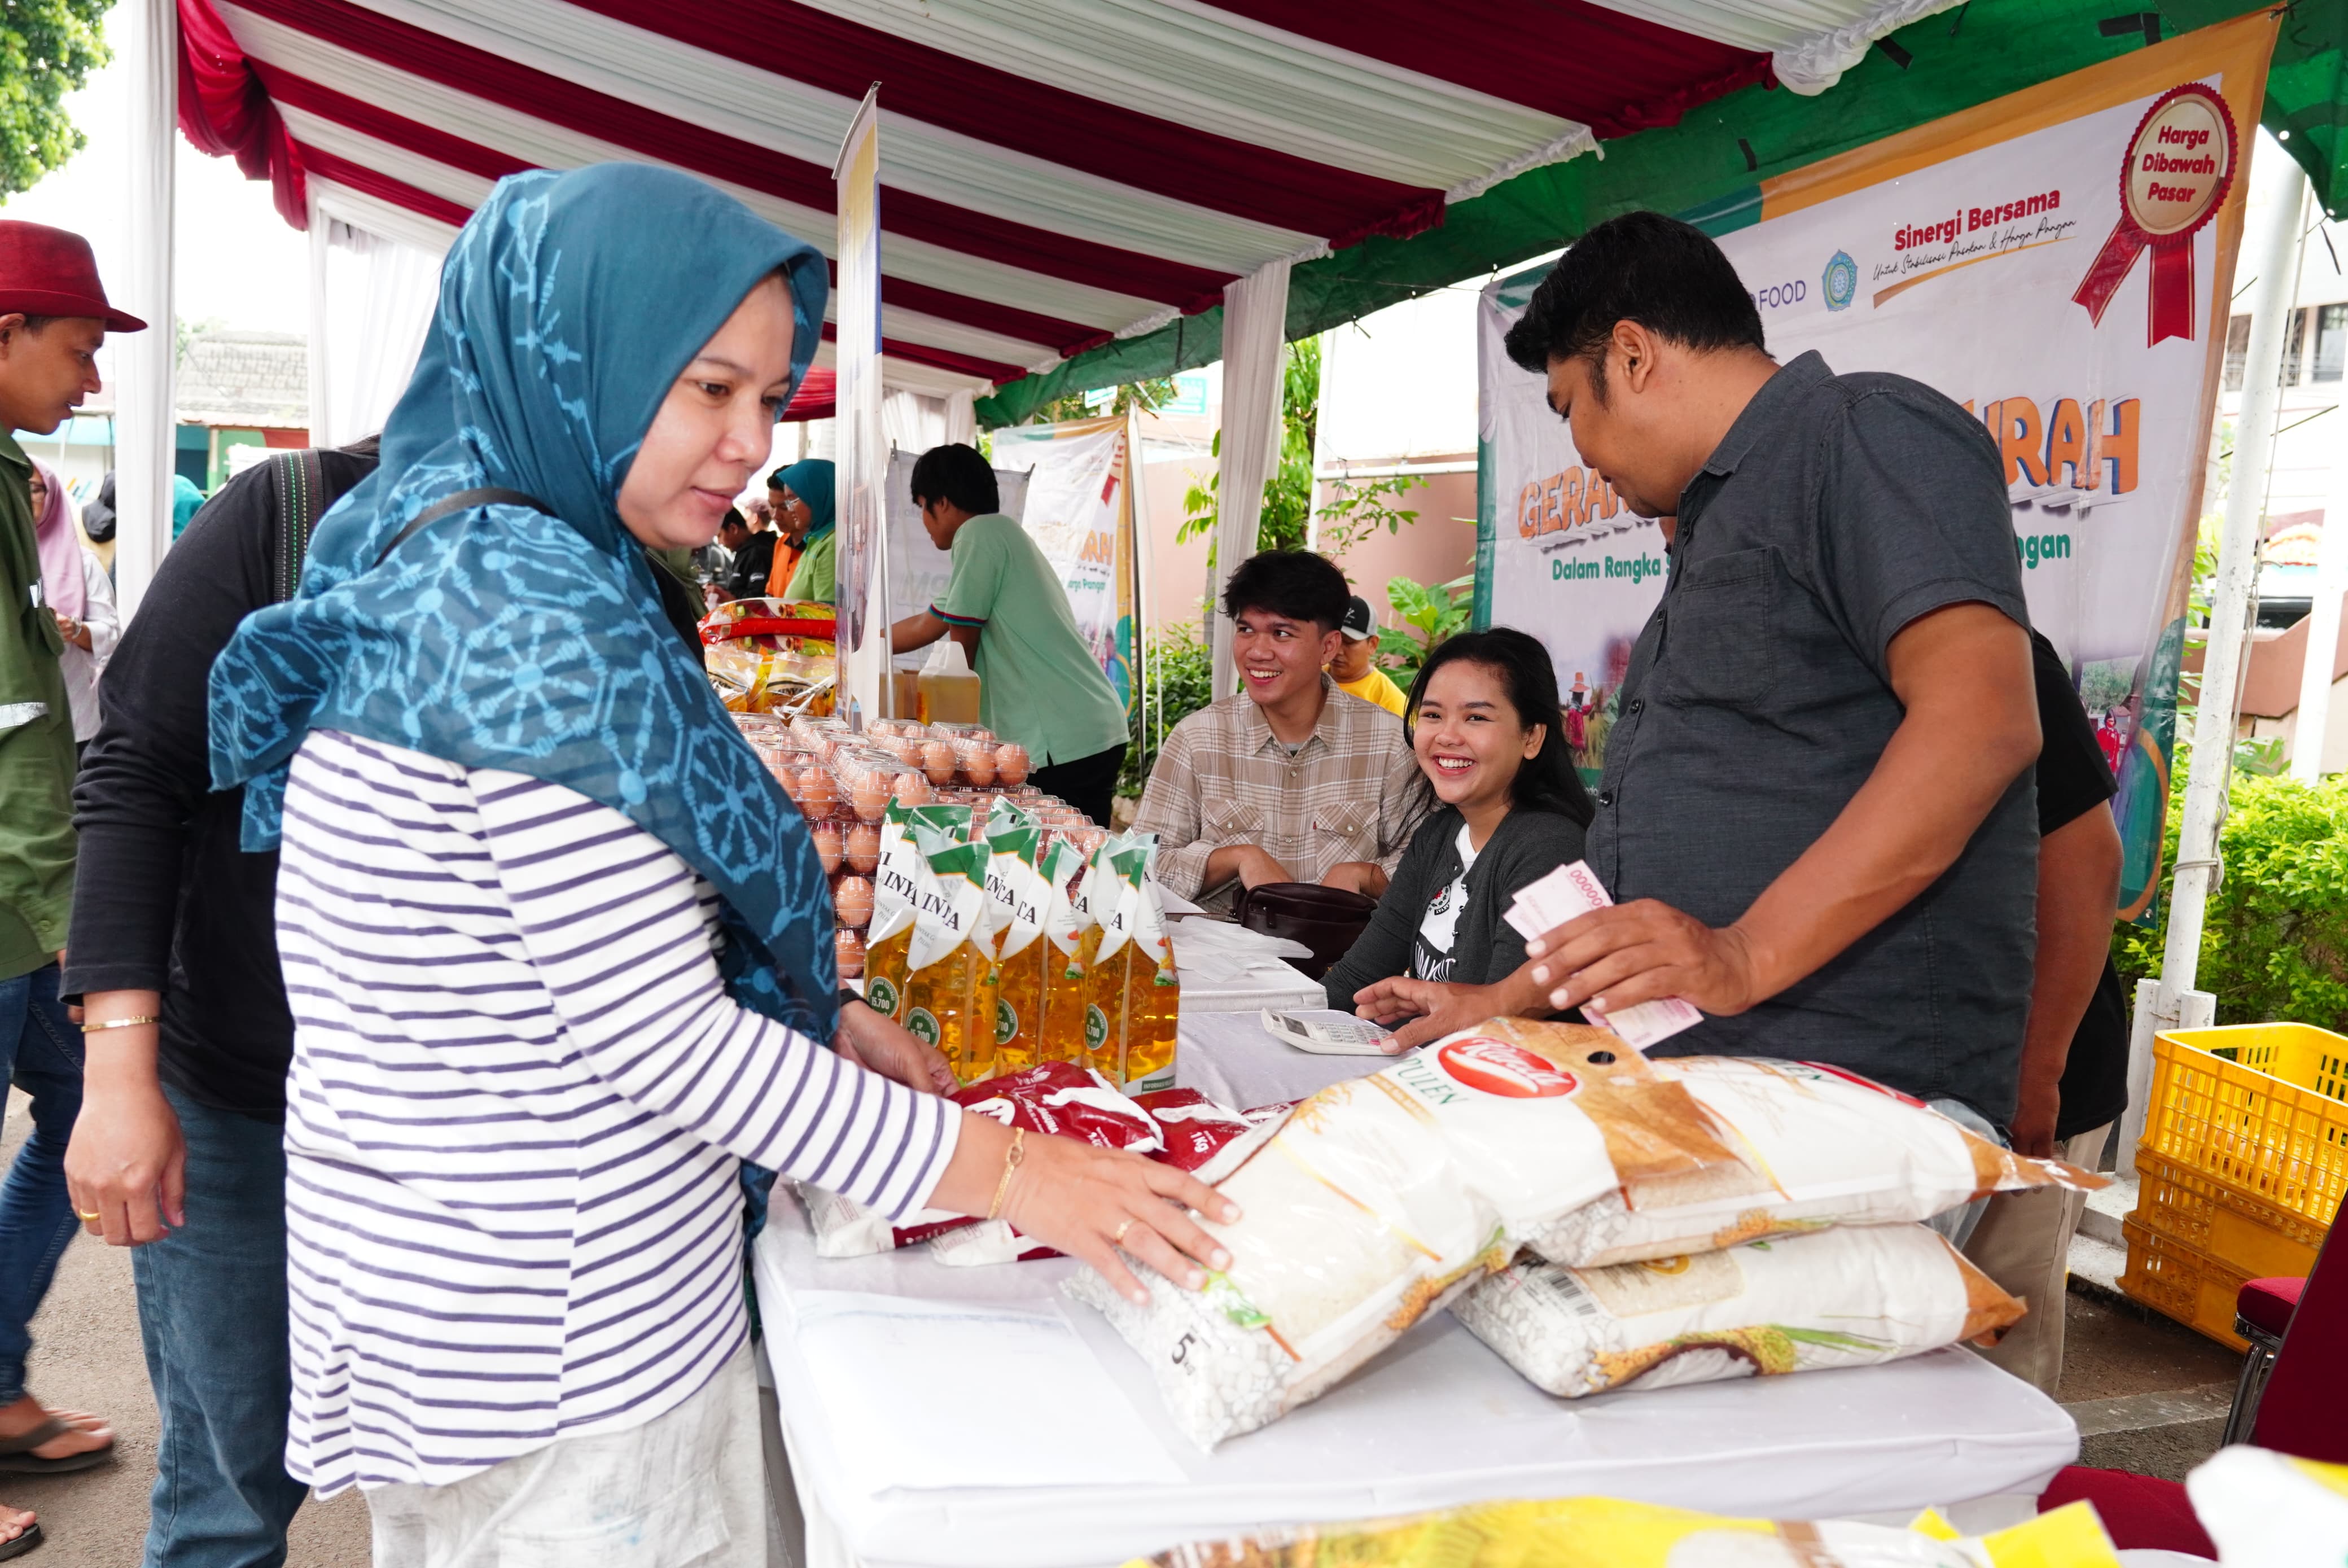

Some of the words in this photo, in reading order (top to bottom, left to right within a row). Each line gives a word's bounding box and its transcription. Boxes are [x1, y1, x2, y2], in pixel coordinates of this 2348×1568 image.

[2158, 125, 2210, 150] Harga
[2142, 152, 2215, 175] Dibawah
[2148, 182, 2196, 203] Pasar
[1894, 209, 1962, 251] Sinergi
[1968, 190, 2061, 232] Bersama
[1873, 263, 1899, 281] Untuk
[1901, 249, 1947, 275] Stabilisasi
[1948, 241, 1986, 262] Pasokan
[1988, 231, 1996, 249] &
[2000, 226, 2033, 255] Harga
[2034, 216, 2078, 240] Pangan
[1759, 280, 1806, 311] FOOD
[1552, 557, 1600, 581] Dalam
[1604, 551, 1661, 585] Rangka
[871, 996, 890, 1010] 15.700
[1172, 1333, 1196, 1365] 5
